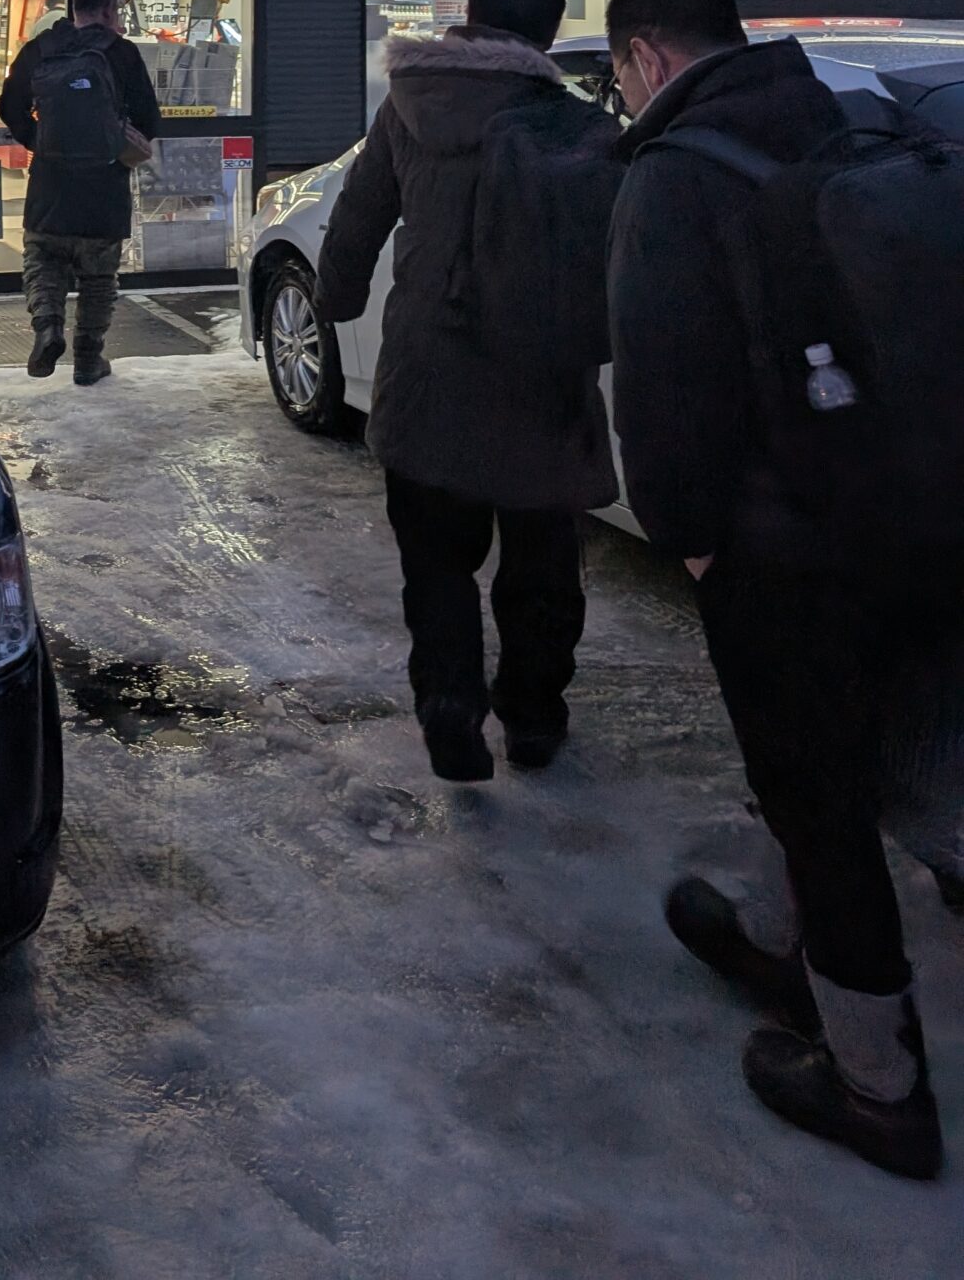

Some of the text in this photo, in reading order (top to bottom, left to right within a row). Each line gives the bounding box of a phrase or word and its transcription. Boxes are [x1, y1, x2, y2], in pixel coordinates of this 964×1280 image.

[138, 2, 193, 12] セイコーマート
